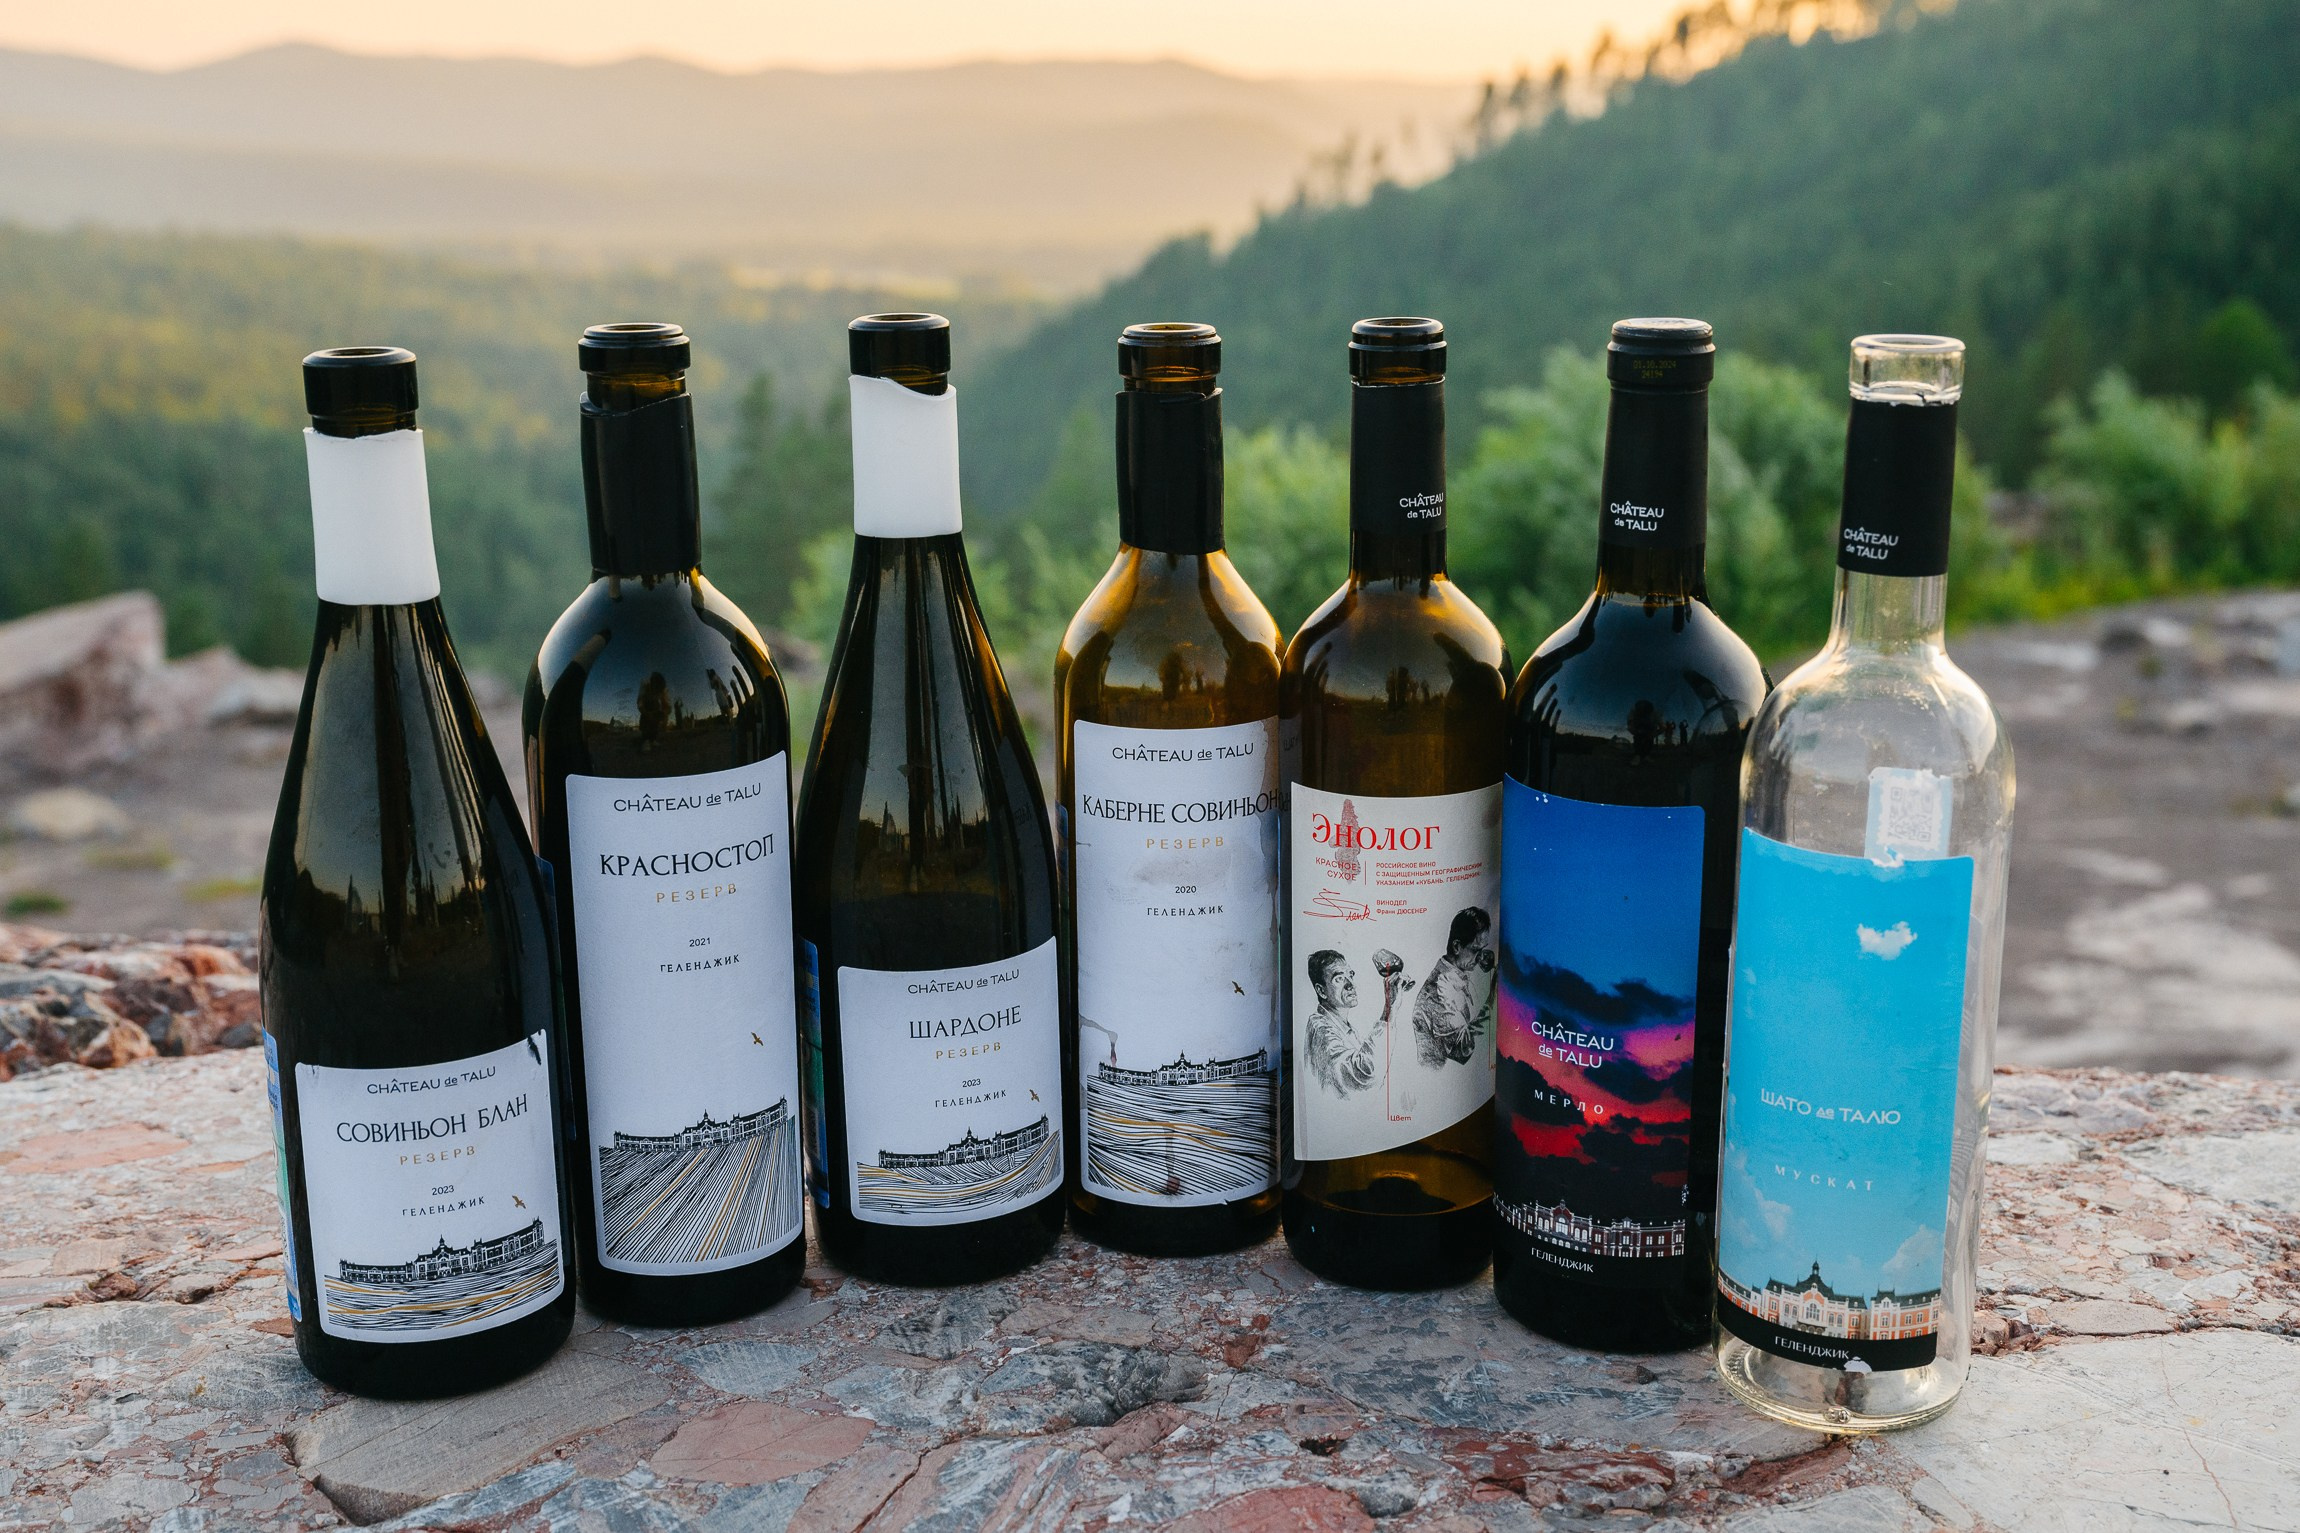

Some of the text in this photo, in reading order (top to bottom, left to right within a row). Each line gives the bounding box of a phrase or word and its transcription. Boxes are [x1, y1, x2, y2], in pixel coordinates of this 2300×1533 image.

[1399, 492, 1444, 508] CHÂTEAU
[1610, 500, 1664, 519] CHÂTEAU
[1407, 506, 1442, 520] de TALU
[1614, 517, 1658, 532] de TALU
[1843, 526, 1899, 547] CHÂTEAU
[1845, 543, 1889, 560] de TALU
[1112, 742, 1254, 762] CHÂTEAU de TALU
[613, 782, 762, 812] CHÂTEAU de TALU
[1082, 794, 1165, 824] КАБЕРНЕ
[1171, 789, 1278, 824] СОВИНЬОН
[1146, 836, 1225, 850] РЕЗЕРВ
[599, 833, 775, 877] КРАСНОСТОП
[1315, 856, 1357, 871] КРАСНОЕ
[1375, 861, 1417, 869] РОССИЙСКОЕ
[1431, 862, 1483, 876] ГЕОГРАФИЧЕСКИМ
[1327, 869, 1358, 881] СУХОЕ
[655, 883, 738, 903] РЕЗЕРВ
[1174, 885, 1197, 894] 2020
[1146, 905, 1224, 917] ГЕЛЕНДЖИК
[1376, 899, 1408, 907] ВИНОДЕЛ
[1397, 907, 1428, 915] ДЮСЕНЕР
[688, 937, 711, 948] 2021
[660, 954, 741, 973] ГЕЛЕНДЖИК
[907, 968, 1020, 994] CHÂTEAU de TALU
[909, 1005, 1022, 1039] ШАРДОНЕ
[1531, 1021, 1614, 1051] CHÂTEAU
[935, 1041, 1002, 1060] РЕЗЕРВ
[1538, 1043, 1603, 1069] de TALU
[366, 1066, 496, 1095] CHÂTEAU de TALU
[961, 1077, 982, 1088] 2023
[935, 1089, 1007, 1108] ГЕЛЕНДЖИК
[1534, 1088, 1605, 1116] МЕРЛО
[1760, 1087, 1812, 1116] ШАТО
[1839, 1107, 1901, 1126] ТАЛЮ
[336, 1093, 529, 1144] СОВИНЬОН БЛАН
[1389, 1114, 1412, 1122] Цвет
[399, 1145, 477, 1166] РЕЗЕРВ
[1774, 1164, 1875, 1193] МУСКАТ
[431, 1184, 455, 1196] 2023
[401, 1195, 486, 1217] ГЕЛЕНДЖИК
[1530, 1246, 1594, 1273] ГЕЛЕНДЖИК
[1774, 1335, 1850, 1360] ГЕЛЕНДЖИК
